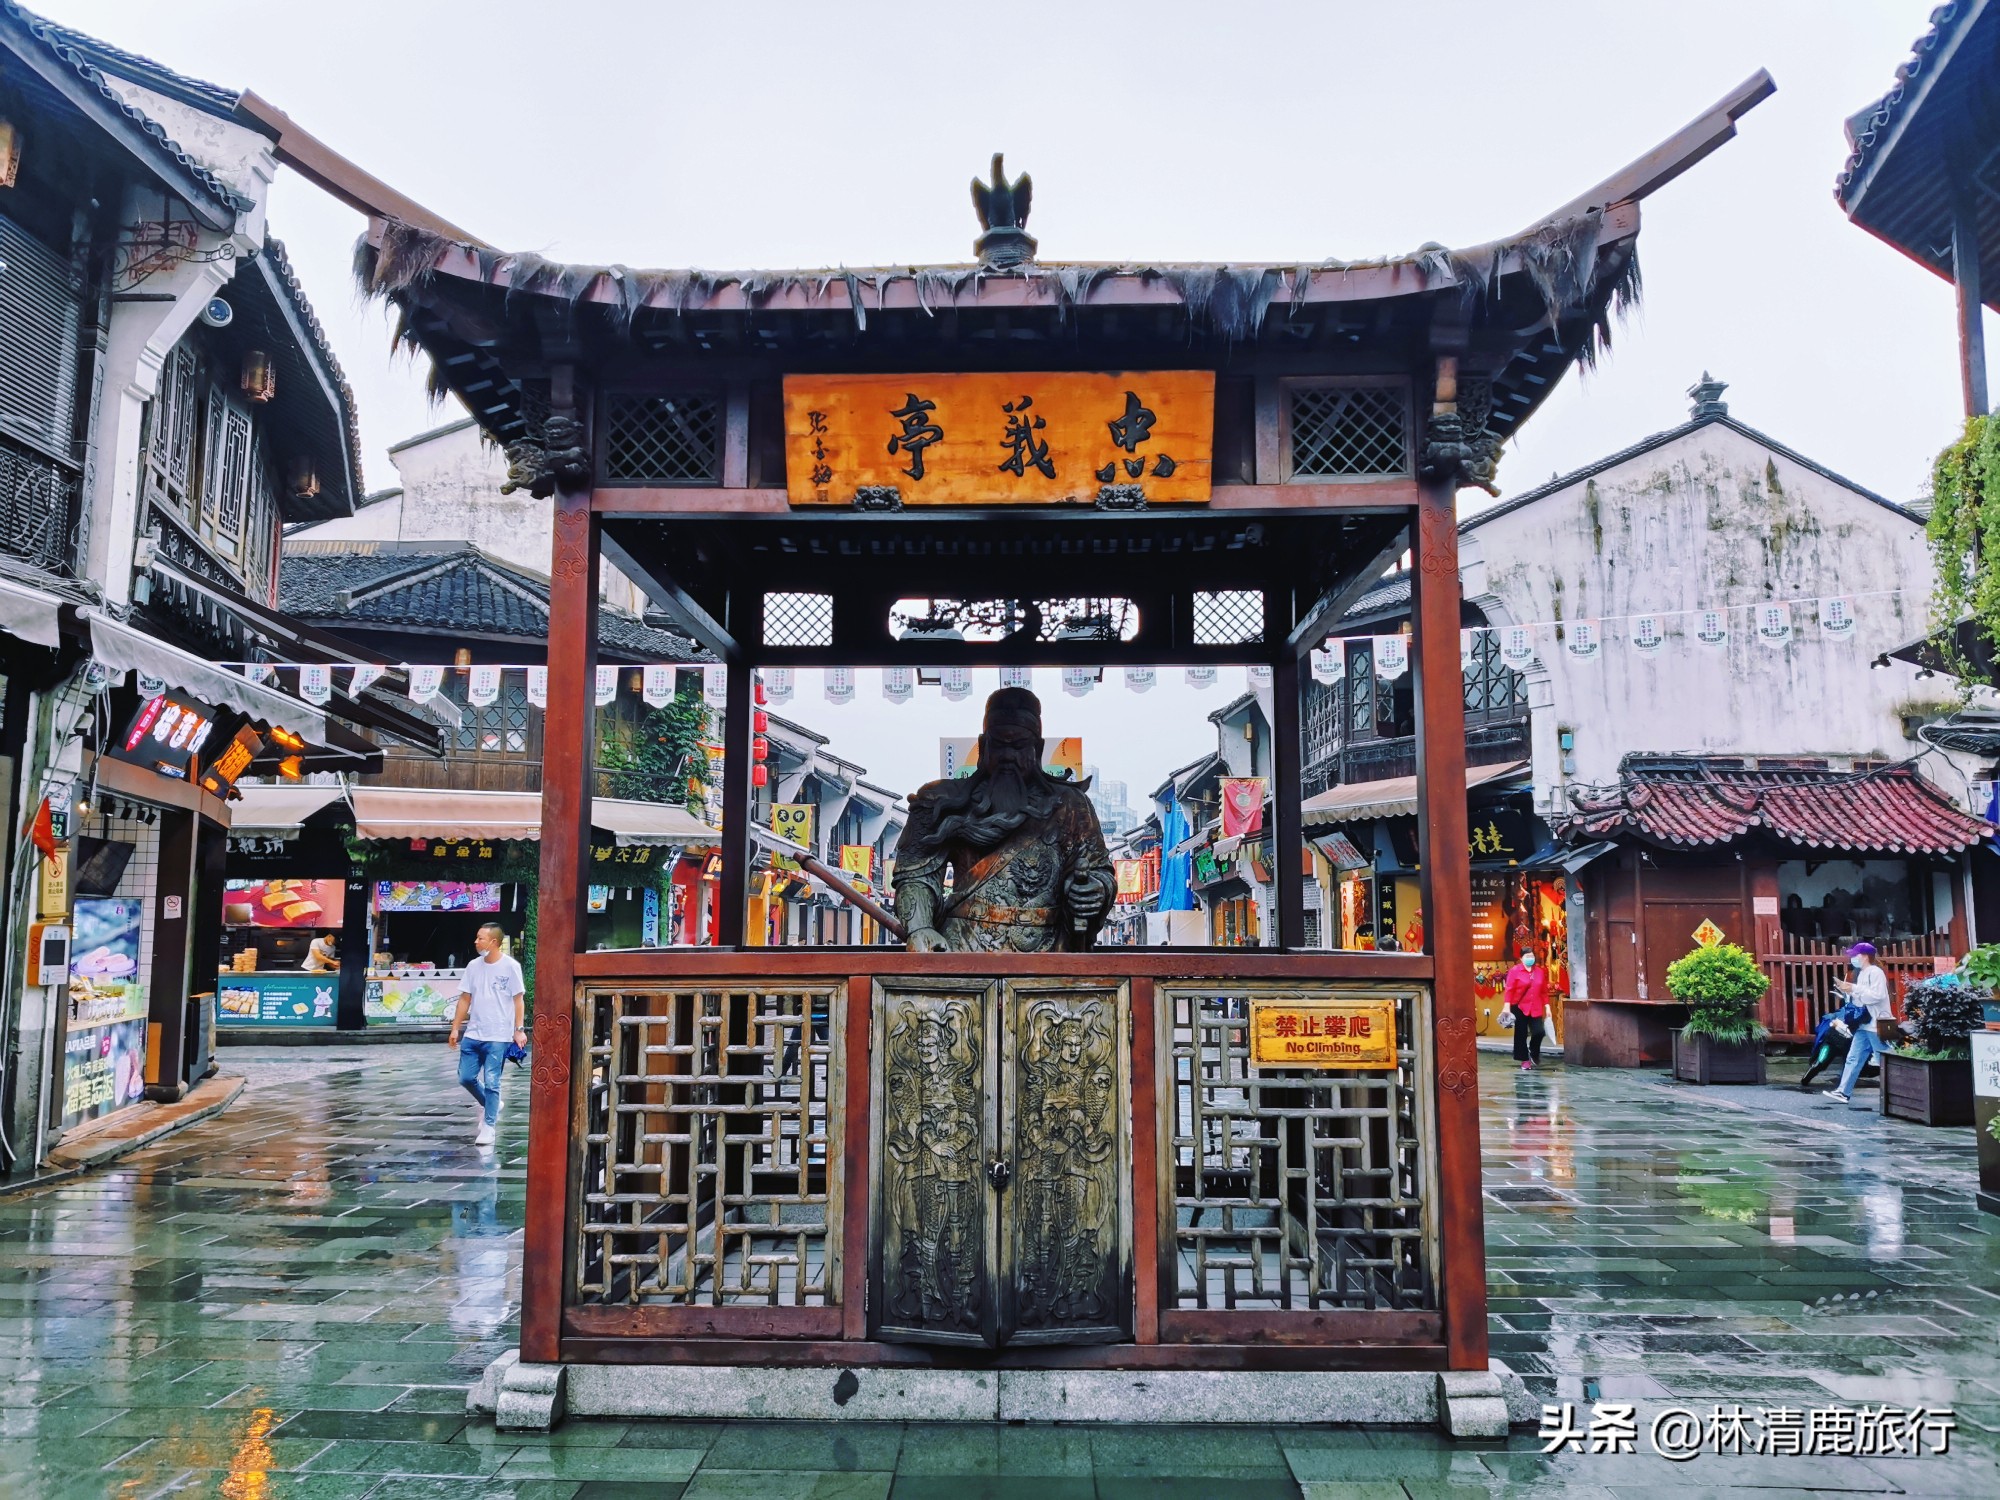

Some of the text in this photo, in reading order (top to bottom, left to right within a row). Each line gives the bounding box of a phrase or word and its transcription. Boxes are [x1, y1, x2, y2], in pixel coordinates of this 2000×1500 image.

[1275, 1015, 1372, 1038] 禁止攀爬
[1286, 1042, 1361, 1054] No Climbing
